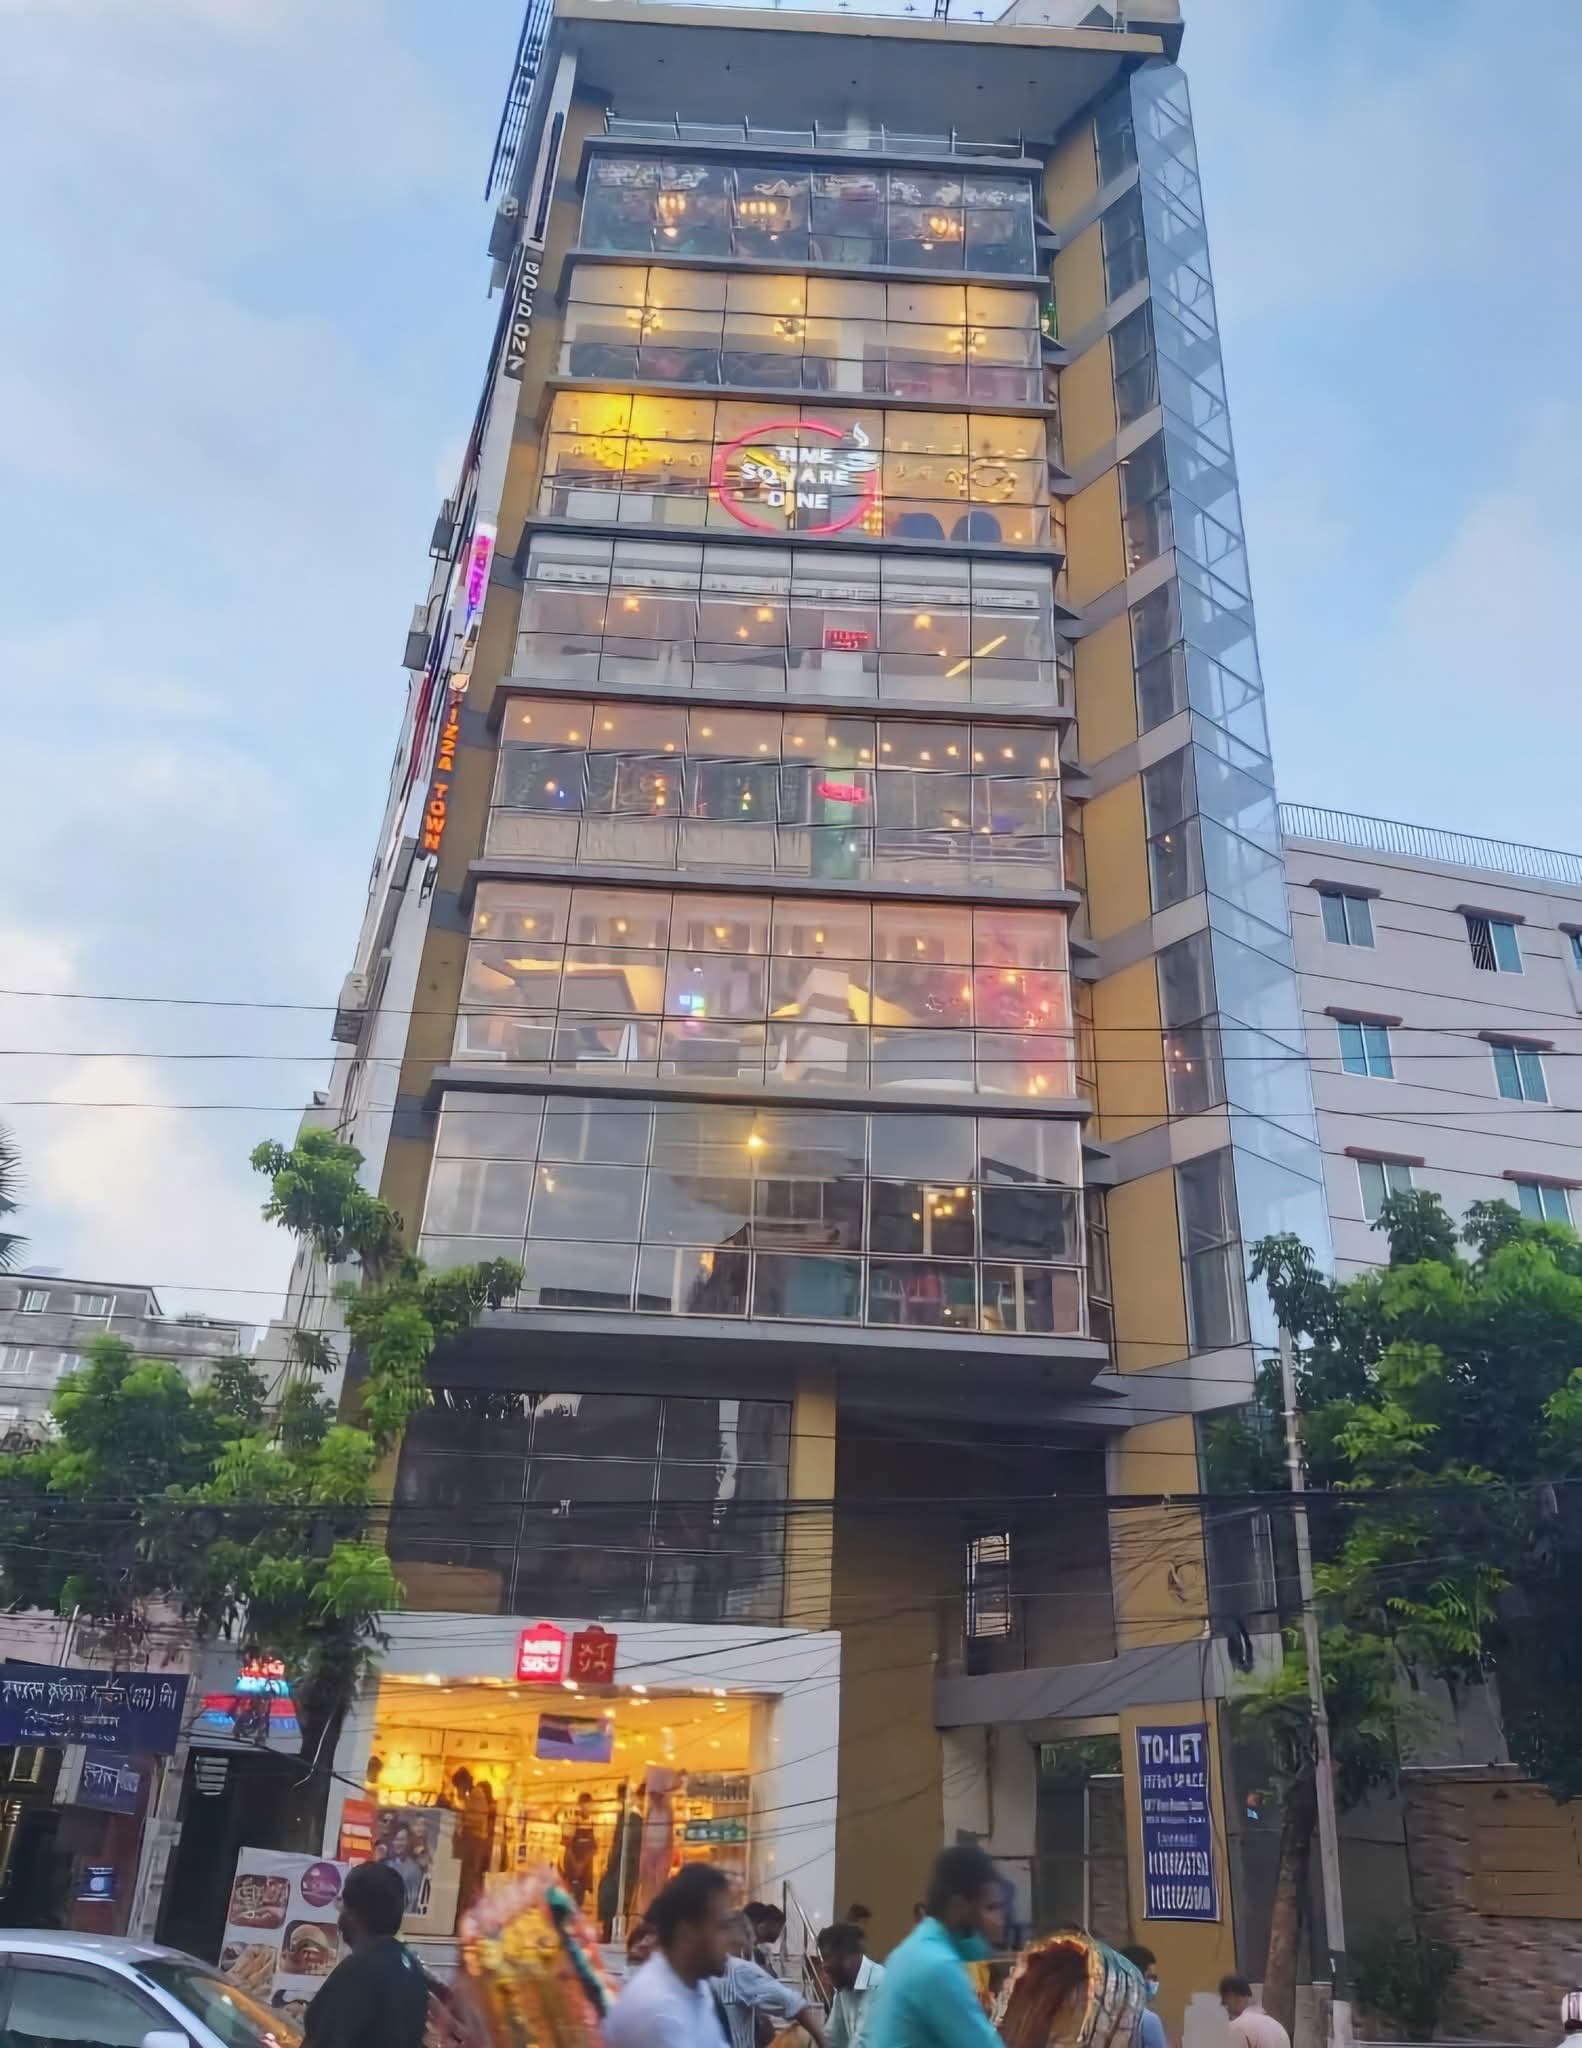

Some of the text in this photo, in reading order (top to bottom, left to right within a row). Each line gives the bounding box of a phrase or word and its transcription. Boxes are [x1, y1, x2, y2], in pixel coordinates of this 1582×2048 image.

[776, 446, 833, 464] TIME
[741, 463, 851, 487] SQARE
[768, 490, 830, 510] DNE
[424, 783, 449, 852] TOWN
